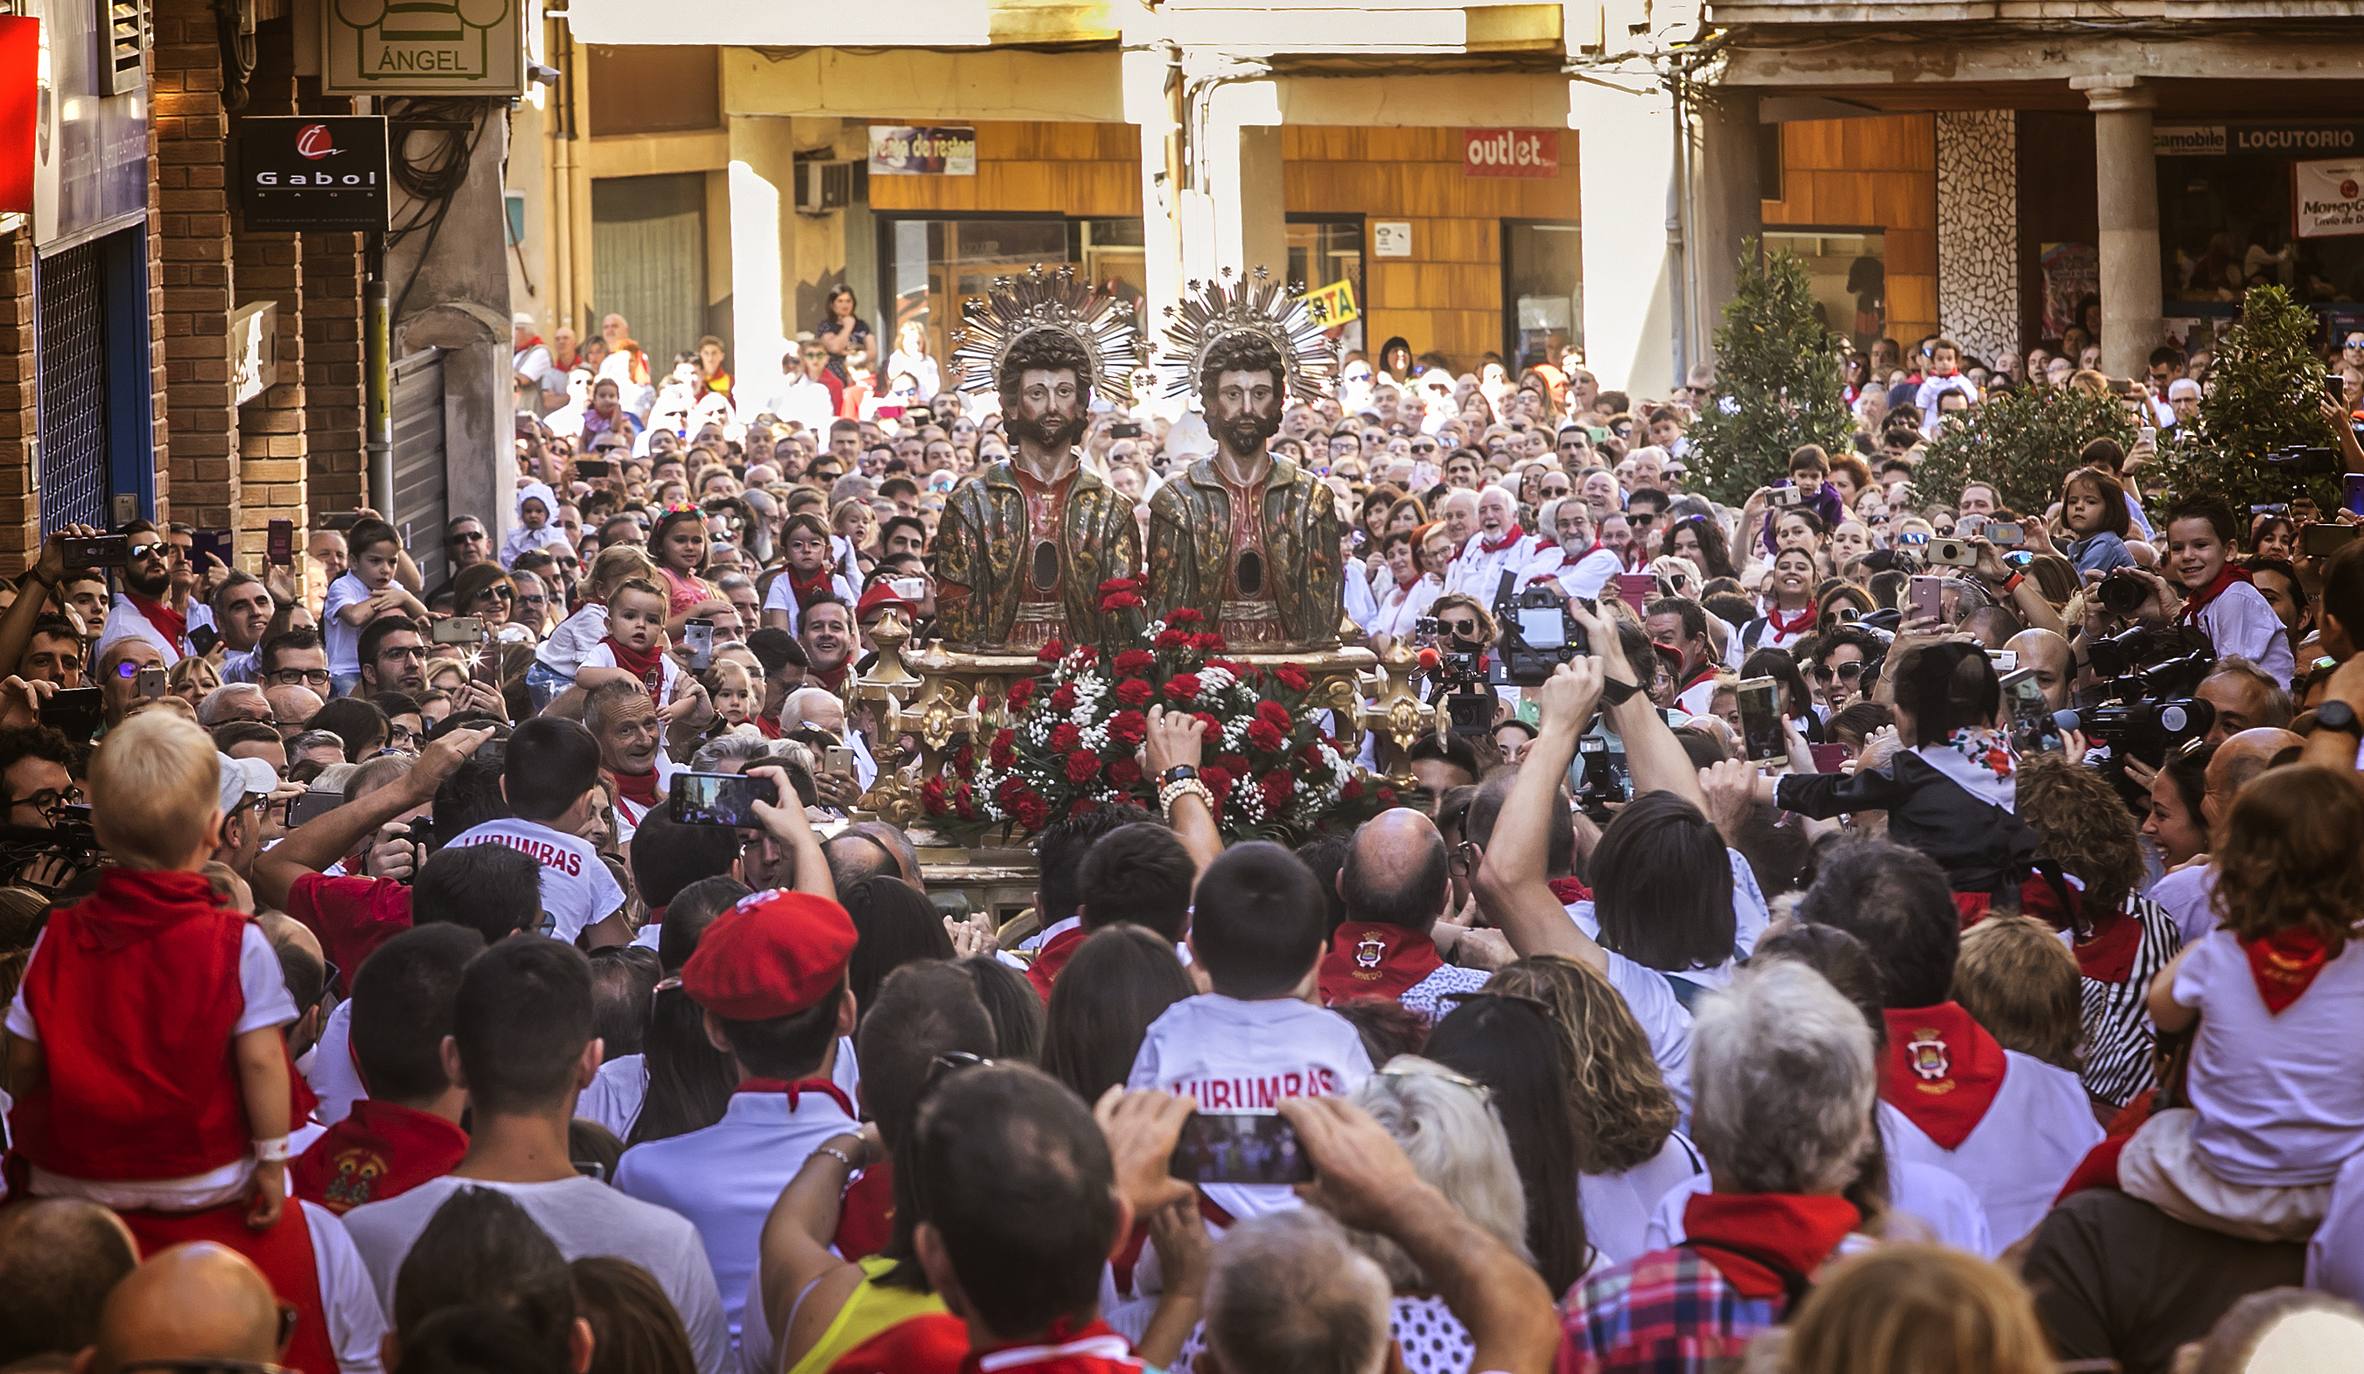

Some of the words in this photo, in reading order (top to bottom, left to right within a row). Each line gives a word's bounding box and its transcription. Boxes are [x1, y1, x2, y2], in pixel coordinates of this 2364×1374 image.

[378, 45, 468, 71] ÁNGEL
[1468, 130, 1541, 166] outlet
[2238, 130, 2355, 149] LOCUTORIO
[256, 171, 376, 185] Gabol
